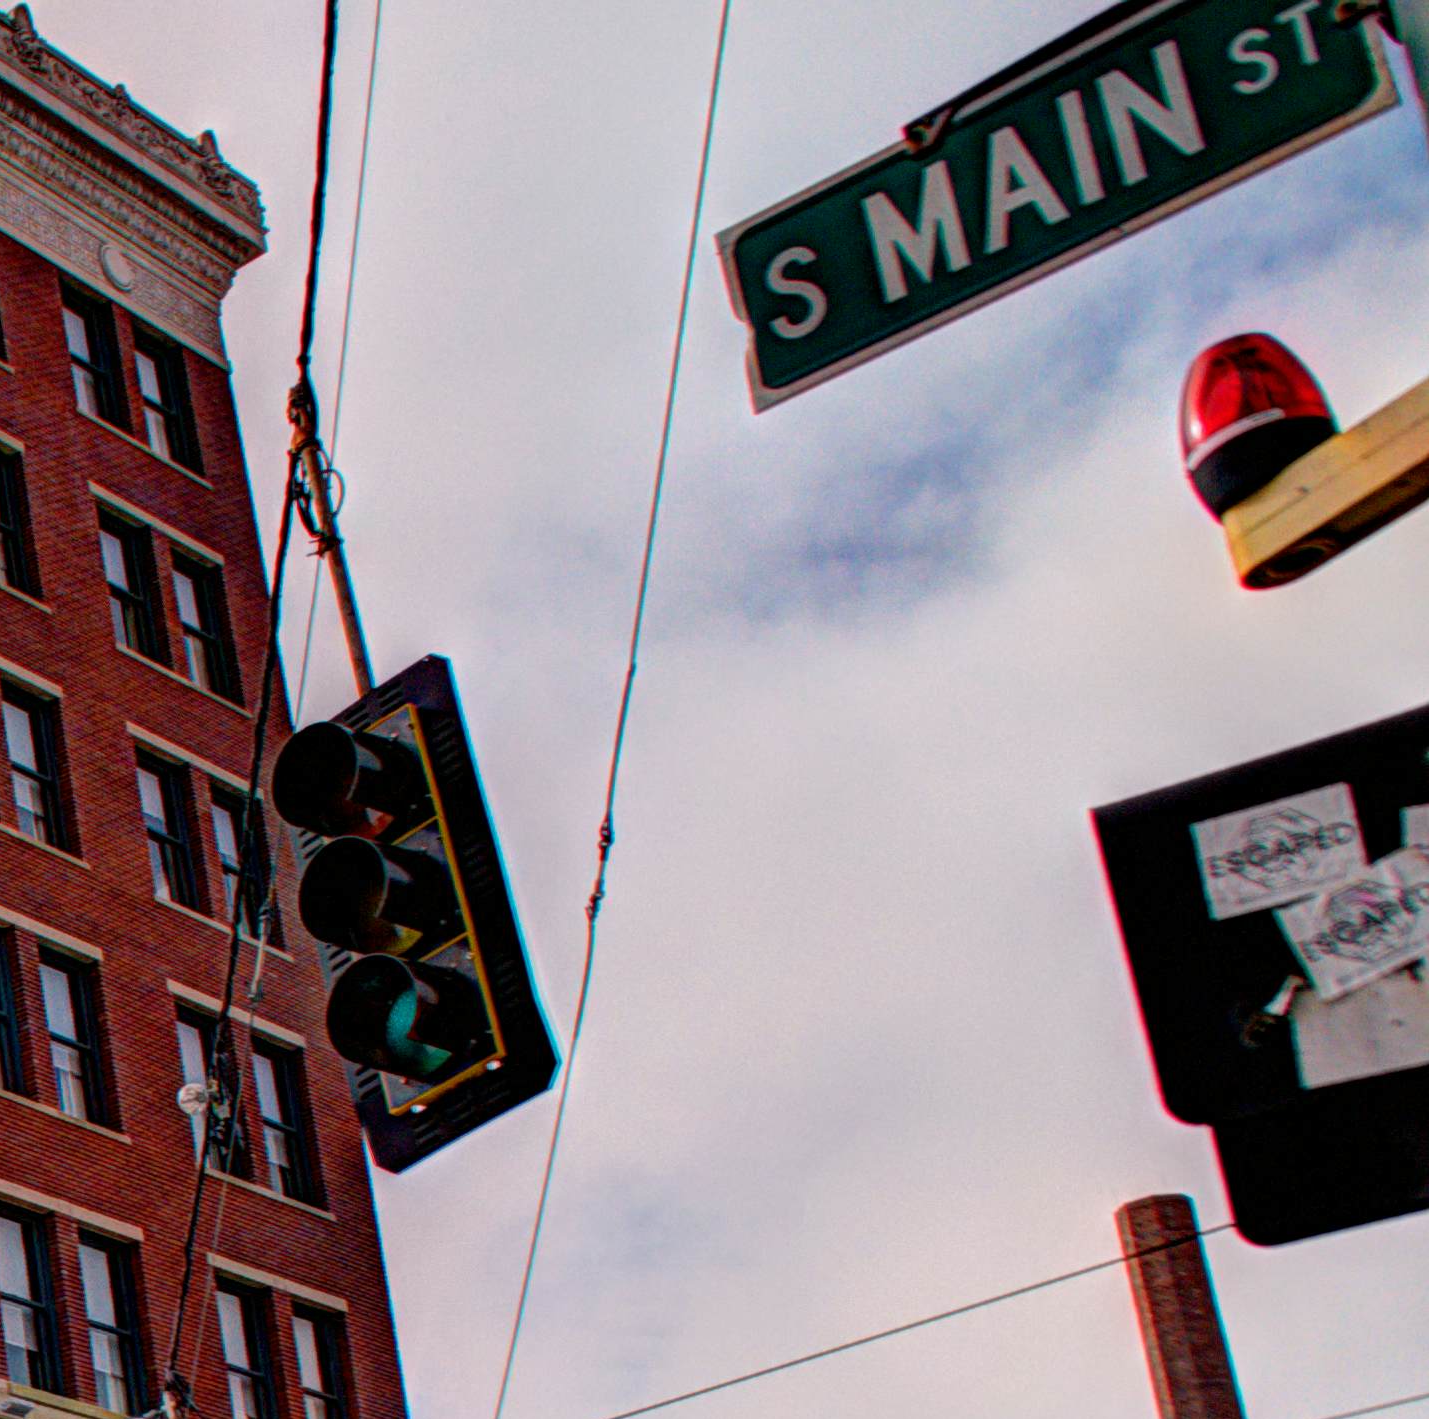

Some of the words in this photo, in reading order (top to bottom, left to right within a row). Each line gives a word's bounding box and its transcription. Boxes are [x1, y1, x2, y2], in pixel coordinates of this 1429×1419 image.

[764, 246, 828, 340] S
[861, 41, 1205, 305] MAIN
[1227, 0, 1322, 95] ST
